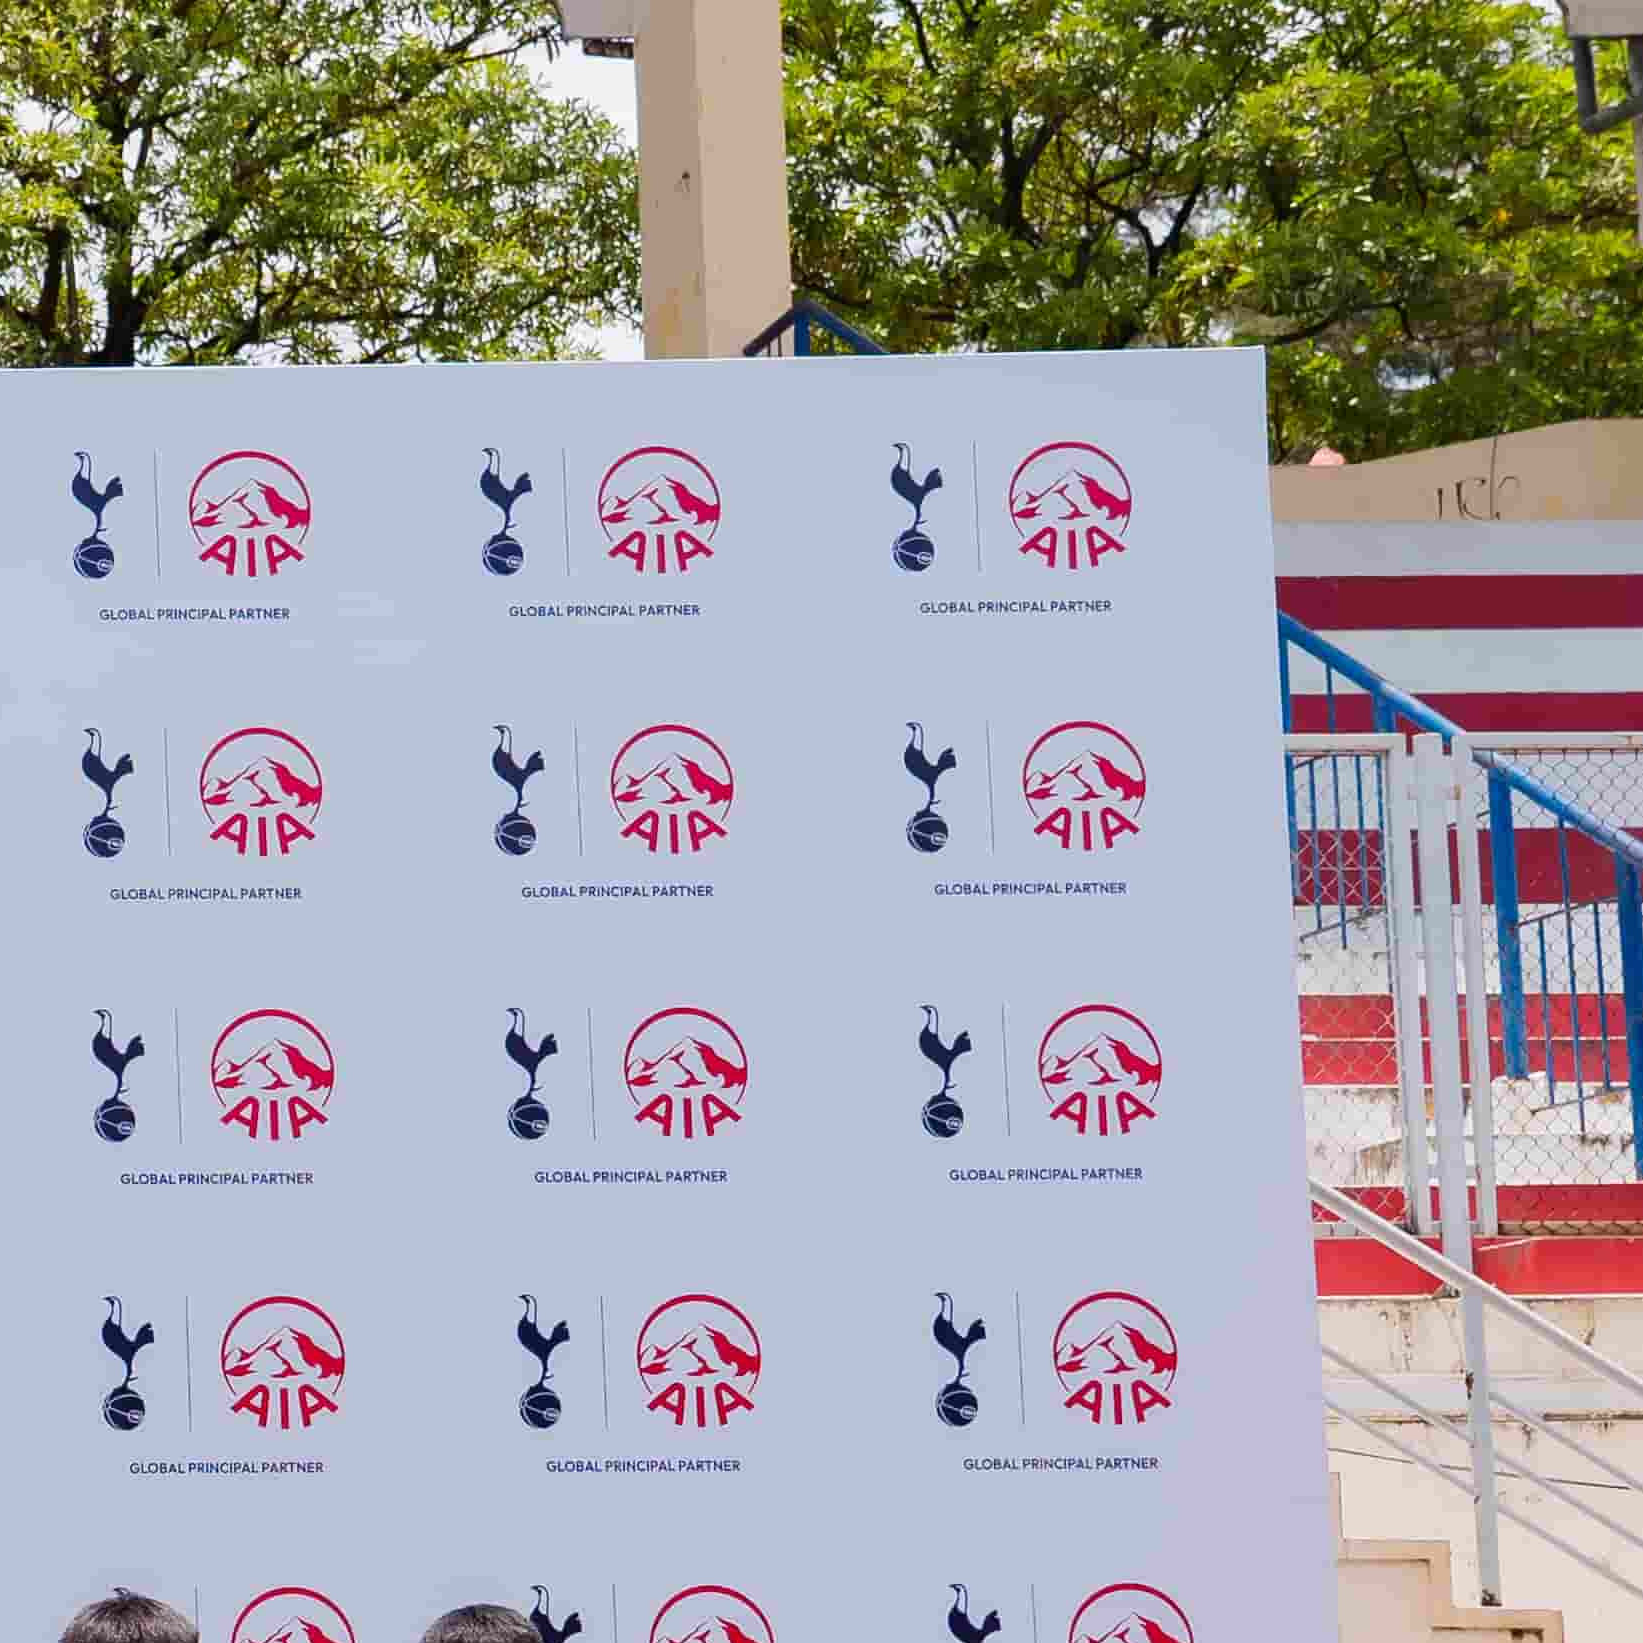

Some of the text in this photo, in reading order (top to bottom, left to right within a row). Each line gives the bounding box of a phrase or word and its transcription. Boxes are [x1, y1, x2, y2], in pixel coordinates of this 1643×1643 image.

[200, 533, 305, 577] AIA
[1020, 526, 1126, 569] AIA
[99, 607, 290, 621] GLOBAL PRINCIPAL PARTNER
[919, 599, 1112, 614] GLOBAL PRINCIPAL PARTNER
[209, 812, 316, 857] AIA
[109, 887, 302, 901] GLOBAL PRINCIPAL PARTNER
[1049, 1090, 1158, 1137] AIA
[949, 1167, 1143, 1181] GLOBAL PRINCIPAL PARTNER
[232, 1383, 340, 1430] AIA
[129, 1461, 324, 1475] GLOBAL PRINCIPAL PARTNER
